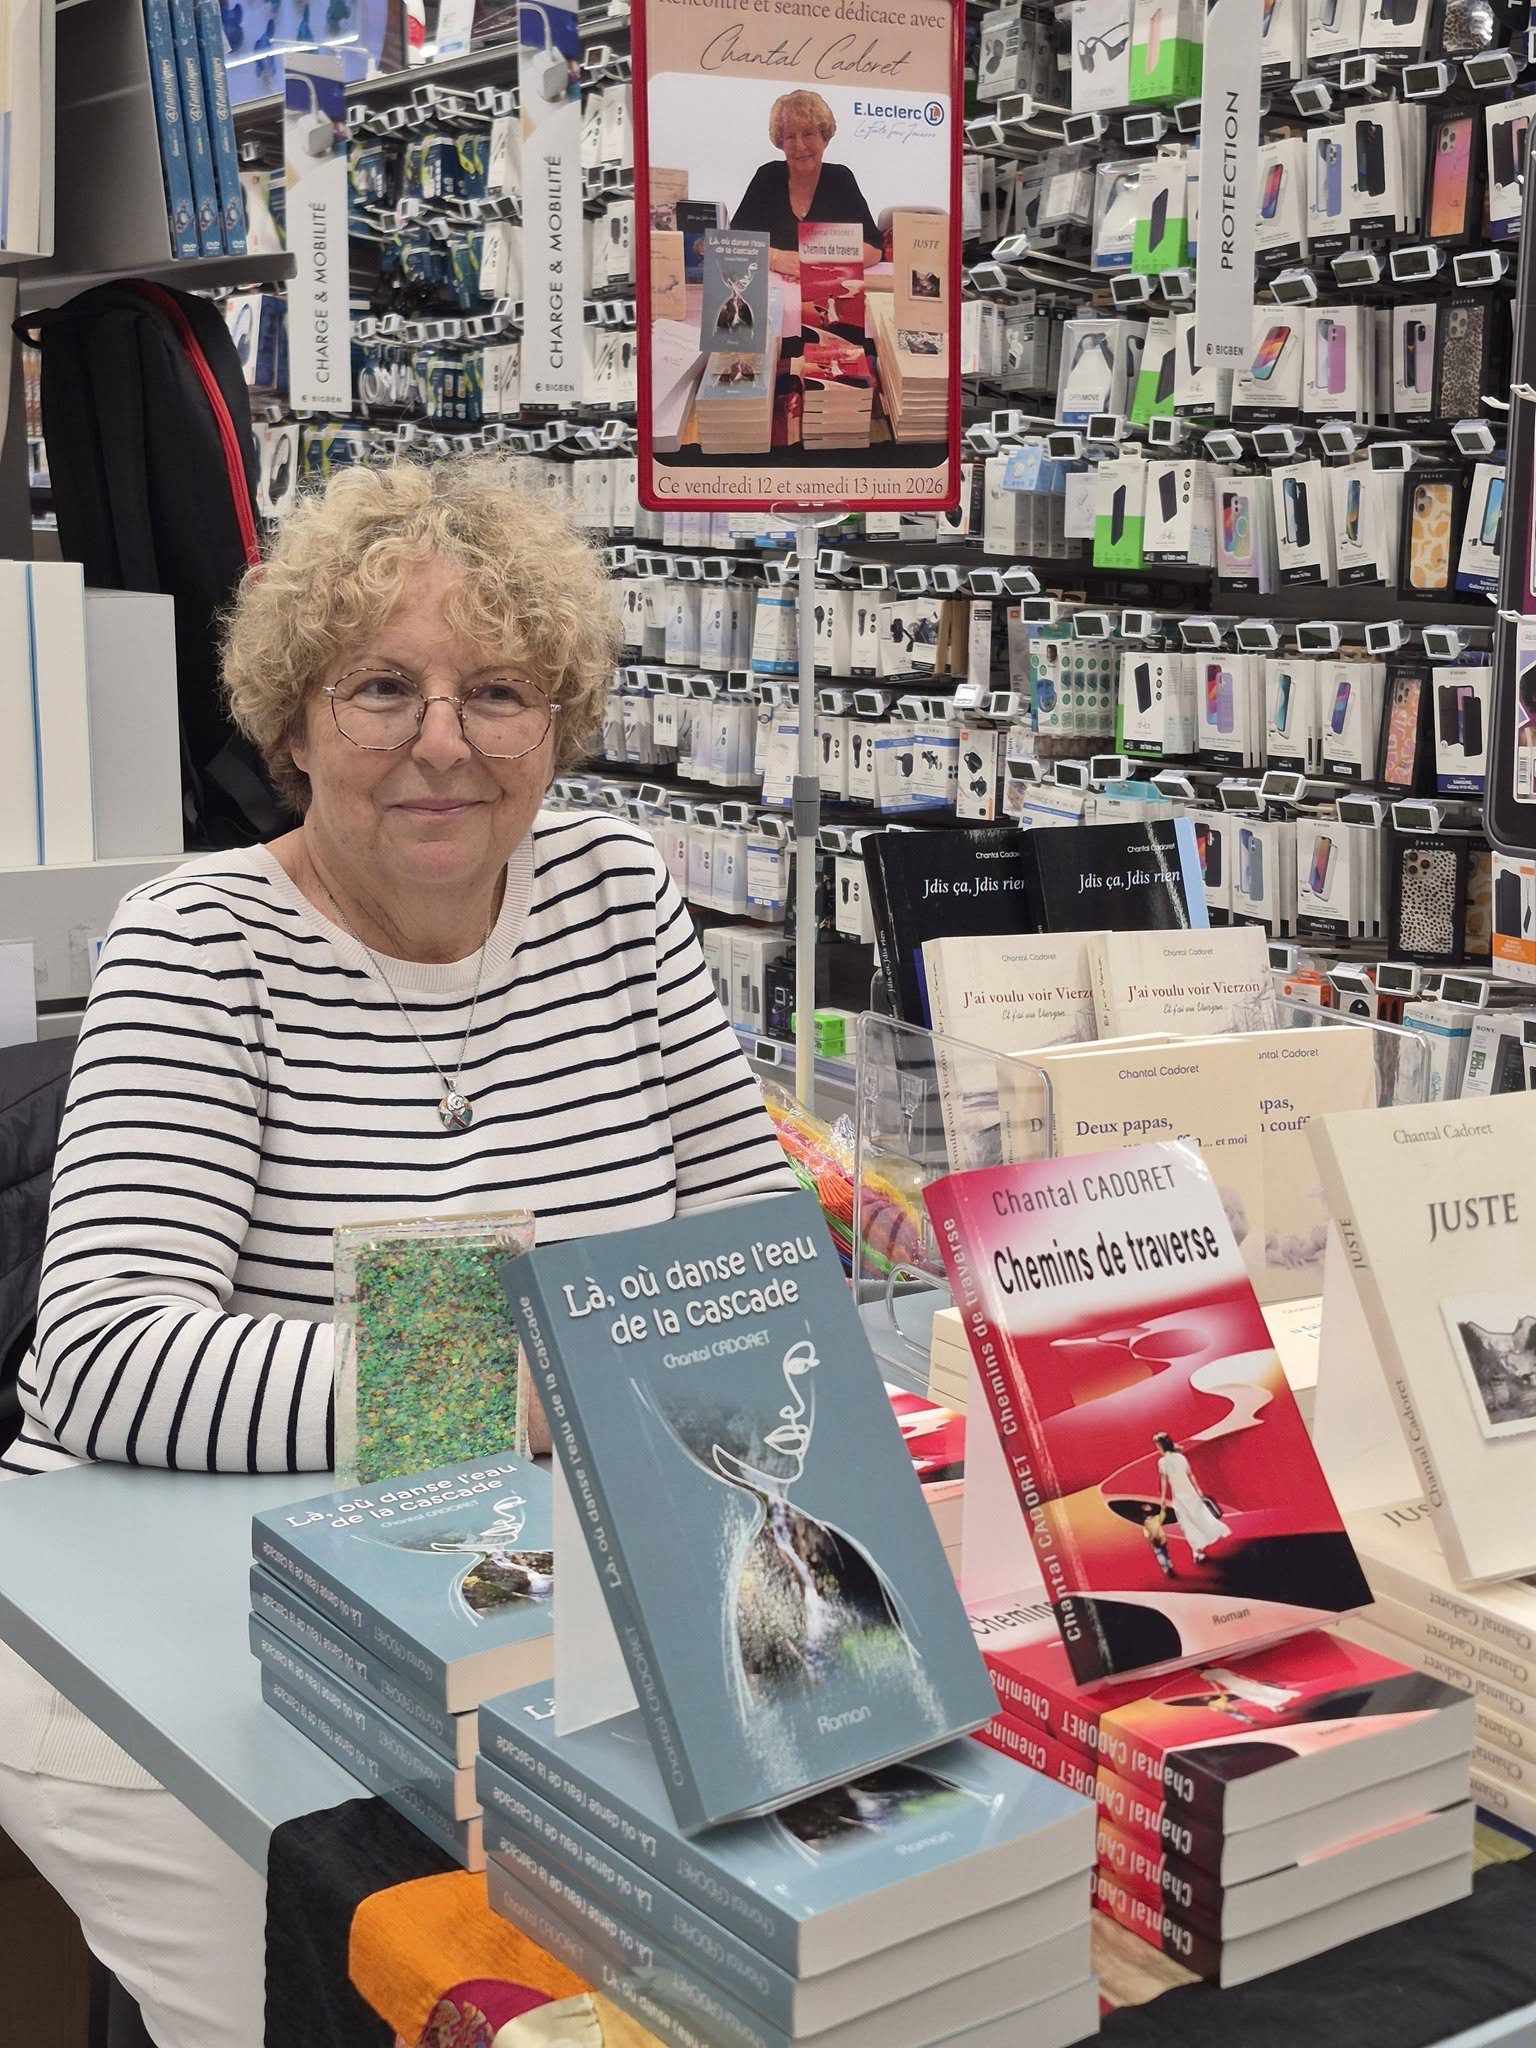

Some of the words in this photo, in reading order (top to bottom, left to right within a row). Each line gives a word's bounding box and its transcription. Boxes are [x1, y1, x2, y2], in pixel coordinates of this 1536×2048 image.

[753, 0, 769, 13] et
[835, 0, 906, 25] dédicace
[910, 13, 946, 29] avec
[700, 23, 813, 71] Chantal
[814, 33, 912, 80] Cadoret
[853, 102, 922, 120] E.Leclerc
[1220, 90, 1240, 270] PROTECTION
[544, 155, 562, 252] MOBILITÉ
[182, 243, 198, 252] DVD
[205, 241, 221, 249] DVD
[232, 239, 246, 248] DVD
[308, 202, 328, 285] MOBILITÉ
[913, 239, 941, 249] JUSTE
[549, 260, 563, 274] &
[314, 291, 329, 303] &
[549, 281, 564, 369] CHARGE
[315, 308, 330, 384] CHARGE
[1215, 344, 1244, 356] BIGBEN
[545, 383, 575, 392] BIGBEN
[658, 475, 680, 494] Ce
[685, 474, 752, 494] vendredi
[758, 476, 773, 494] 12
[777, 479, 793, 494] et
[796, 475, 849, 495] samedi
[854, 477, 869, 494] 13
[871, 476, 901, 500] juin
[905, 477, 944, 494] 2026
[975, 851, 999, 861] Chantal
[1127, 844, 1151, 854] Chantal
[1151, 842, 1176, 852] Cadoret
[922, 878, 949, 899] Jdis
[953, 880, 972, 898] ça,
[973, 876, 999, 898] Jdis
[1078, 873, 1103, 894] Jdis
[1105, 873, 1125, 891] ça,
[1126, 870, 1151, 892] Jdis
[1153, 869, 1181, 884] rien
[1001, 953, 1028, 963] Chantal
[1029, 952, 1057, 962] Cadoret
[1163, 948, 1187, 958] Chantal
[1188, 947, 1214, 957] Cadoret
[963, 990, 986, 1009] J'ai
[989, 990, 1025, 1004] voulu
[1028, 989, 1053, 1002] voir
[1055, 986, 1093, 1001] Vierz
[1127, 985, 1149, 1003] J'ai
[1151, 984, 1185, 998] voulu
[1187, 983, 1210, 996] voir
[1212, 980, 1261, 995] Vierzon
[1475, 1024, 1496, 1033] SONY
[1281, 1047, 1319, 1059] Cadoret
[940, 1049, 952, 1101] Vierzon
[1118, 1067, 1158, 1080] Chantal
[1159, 1064, 1200, 1078] Cadoret
[1075, 1120, 1118, 1137] Deux
[1122, 1116, 1174, 1138] papas,
[1215, 1137, 1226, 1146] et
[1227, 1134, 1249, 1145] moi
[1393, 1126, 1441, 1145] Chantal
[1443, 1122, 1494, 1140] Cadoret
[992, 1179, 1079, 1217] Chantal
[1082, 1164, 1176, 1203] CADORET
[1427, 1192, 1519, 1244] JUSTE
[1339, 1217, 1367, 1270] JUSTE
[942, 1216, 980, 1308] traverse
[993, 1238, 1094, 1295] Chemins
[1096, 1230, 1127, 1278] de
[1127, 1224, 1220, 1273] traverse
[562, 1276, 617, 1319] Là,
[619, 1264, 662, 1300] où
[665, 1251, 746, 1291] danse
[750, 1235, 819, 1274] l'eau
[519, 1295, 552, 1372] cascade
[610, 1313, 648, 1346] de
[653, 1307, 681, 1338] la
[971, 1310, 990, 1339] de
[663, 1340, 712, 1370] Chantal
[711, 1328, 771, 1359] CADORET
[545, 1371, 559, 1394] la
[981, 1343, 1019, 1436] Chemins
[551, 1393, 567, 1418] de
[561, 1419, 581, 1468] l'eau
[1415, 1447, 1443, 1509] Chantal
[286, 1508, 334, 1529] Là,
[336, 1493, 376, 1516] où
[379, 1477, 453, 1507] danse
[457, 1462, 518, 1485] l'eau
[330, 1512, 366, 1530] de
[370, 1505, 394, 1521] la
[398, 1478, 505, 1515] cascade
[576, 1469, 599, 1523] danse
[1011, 1453, 1054, 1548] CADORET
[593, 1526, 608, 1553] où
[1043, 1554, 1082, 1643] Chantal
[1429, 1591, 1480, 1629] Cadoret
[1212, 1607, 1250, 1626] Roman
[1425, 1622, 1475, 1659] Cadoret
[1482, 1618, 1533, 1651] Chantal
[1479, 1645, 1529, 1684] Chantal
[988, 1668, 1050, 1722] Chemins
[816, 1704, 873, 1735] Roman
[983, 1720, 1047, 1771] Chemins
[1061, 1709, 1128, 1766] CADORET
[496, 1735, 536, 1772] cascade
[537, 1761, 547, 1781] la
[548, 1769, 562, 1789] de
[1131, 1748, 1196, 1804] Chantal
[562, 1779, 588, 1809] l'eau
[1057, 1759, 1125, 1817] CADORET
[588, 1798, 620, 1829] danse
[619, 1817, 637, 1841] où
[1128, 1798, 1193, 1855] Chantal
[638, 1828, 657, 1858] Là,
[1129, 1897, 1193, 1956] Chantal
